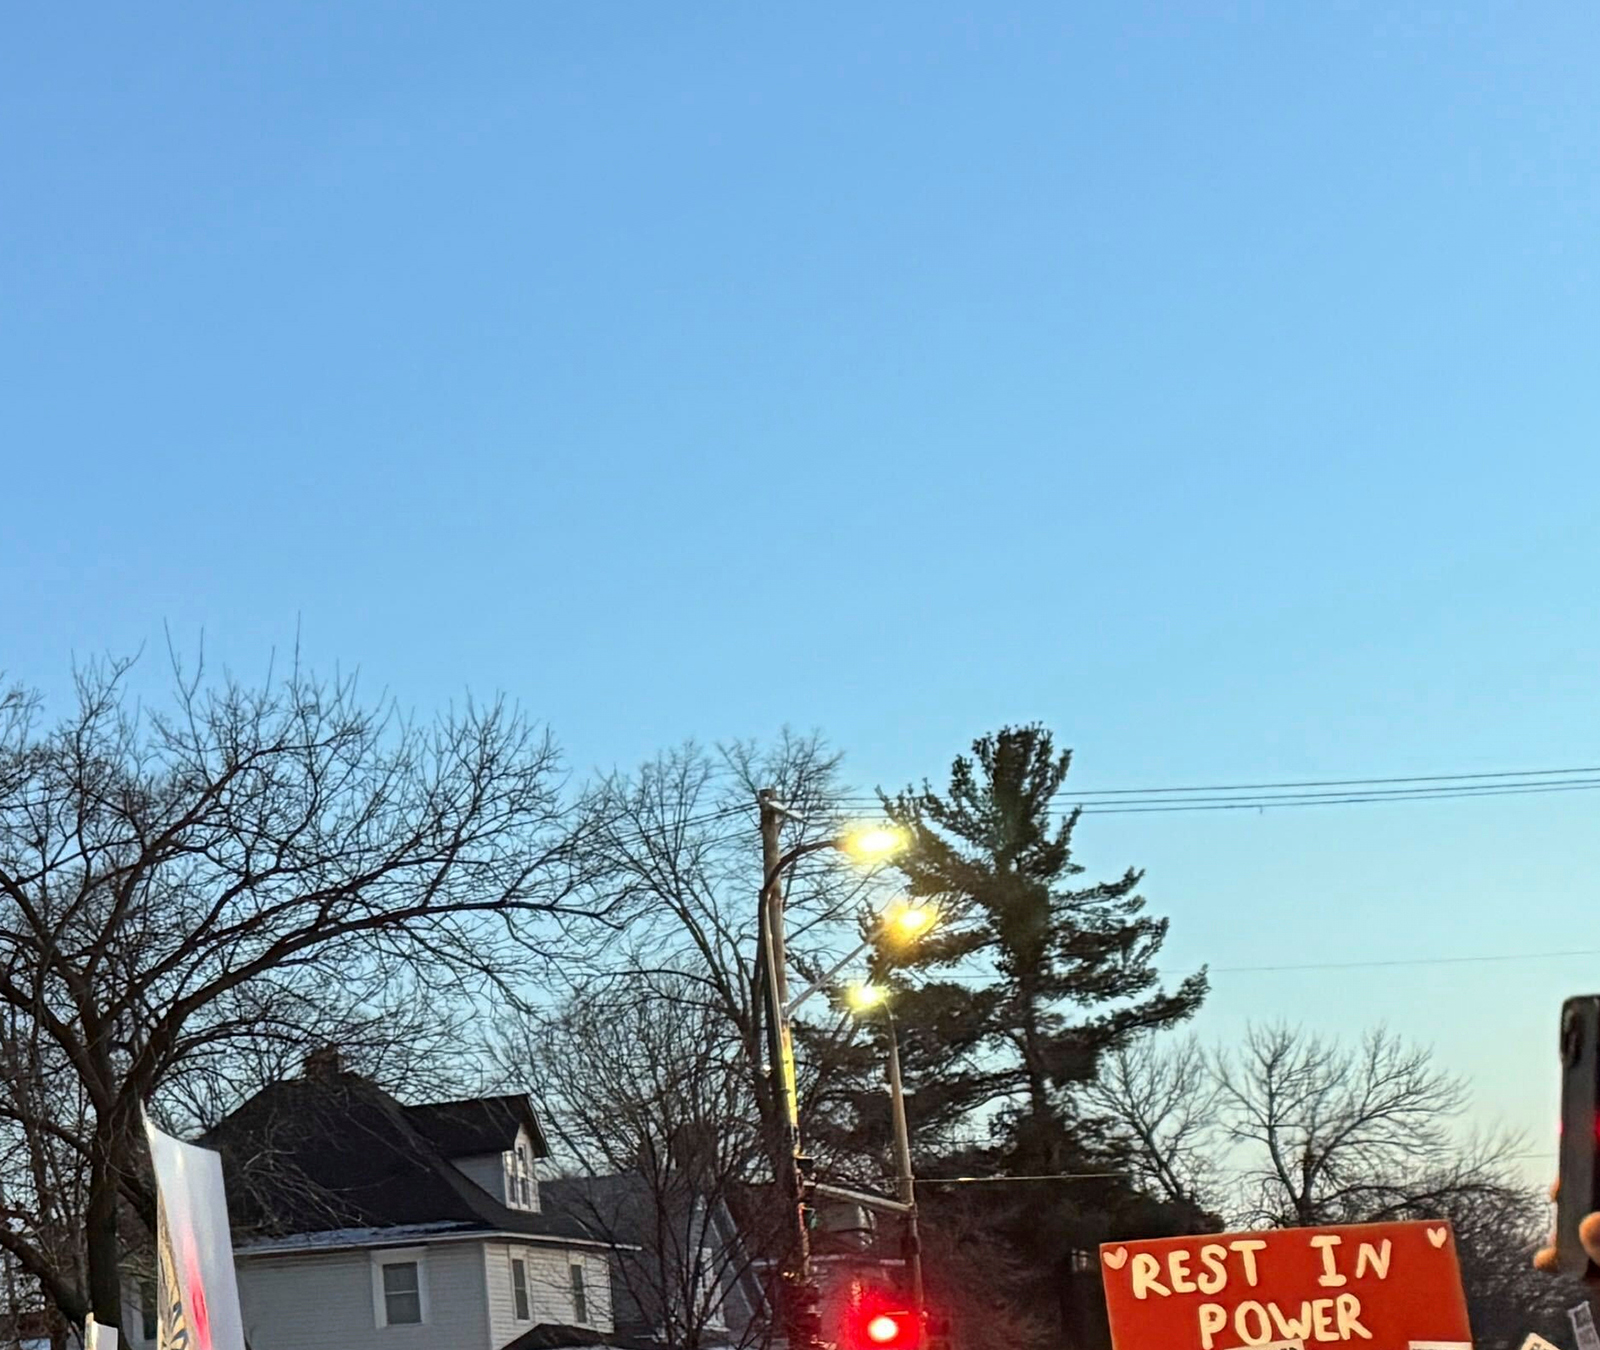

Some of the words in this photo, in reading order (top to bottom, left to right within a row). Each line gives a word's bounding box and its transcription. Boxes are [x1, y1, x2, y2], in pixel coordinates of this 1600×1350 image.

[1131, 1240, 1267, 1299] REST
[1310, 1235, 1392, 1287] IN
[1198, 1294, 1373, 1350] POWER
